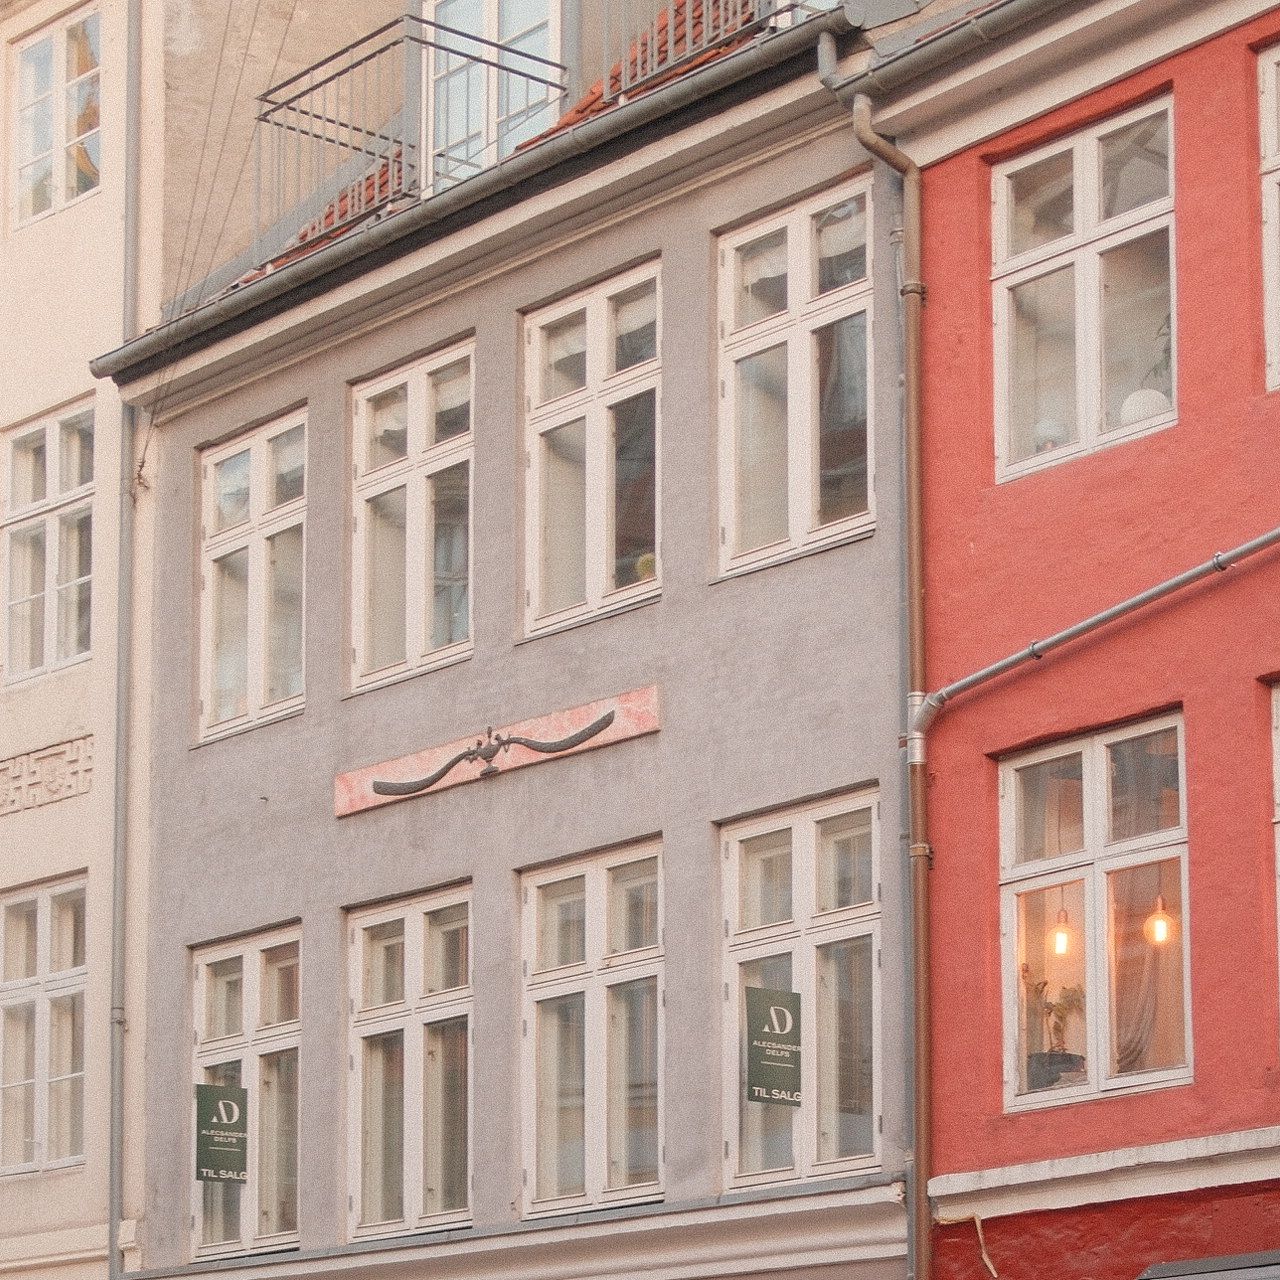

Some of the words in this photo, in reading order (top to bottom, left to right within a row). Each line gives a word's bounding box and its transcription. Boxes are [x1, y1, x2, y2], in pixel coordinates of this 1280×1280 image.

[752, 1086, 770, 1098] TIL
[771, 1089, 802, 1101] SALG
[201, 1168, 218, 1178] TIL
[219, 1170, 248, 1180] SALG
